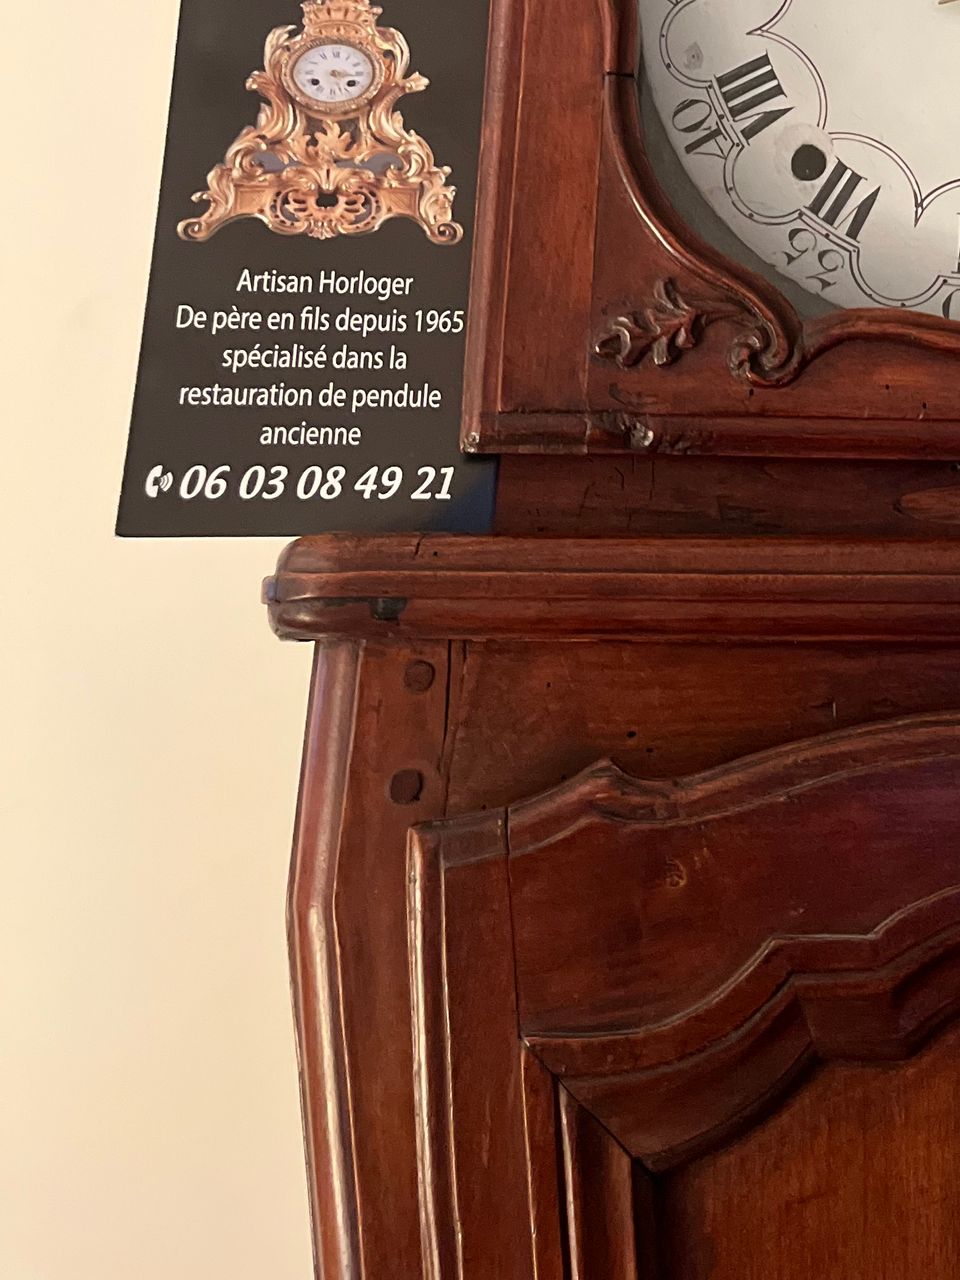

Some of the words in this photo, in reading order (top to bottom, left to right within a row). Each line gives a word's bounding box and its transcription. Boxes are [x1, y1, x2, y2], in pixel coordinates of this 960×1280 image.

[714, 50, 795, 146] VIII
[672, 99, 728, 159] 40
[785, 228, 845, 291] 35
[236, 269, 313, 293] Artisan
[319, 270, 414, 300] Horloger
[176, 305, 207, 329] De
[212, 306, 261, 335] père
[268, 310, 294, 330] en
[300, 306, 330, 331] fils
[335, 308, 407, 337] depuis
[414, 310, 464, 333] 1965
[222, 344, 326, 373] spécialisé
[332, 344, 383, 369] dans
[389, 345, 407, 370] la
[179, 382, 312, 407] restauration
[319, 382, 346, 408] de
[352, 383, 442, 412] pendule
[259, 422, 361, 446] ancienne
[179, 465, 230, 500] 06
[238, 465, 289, 500] 03
[296, 466, 345, 500] 08
[354, 466, 402, 500] 49
[410, 466, 456, 500] 21
